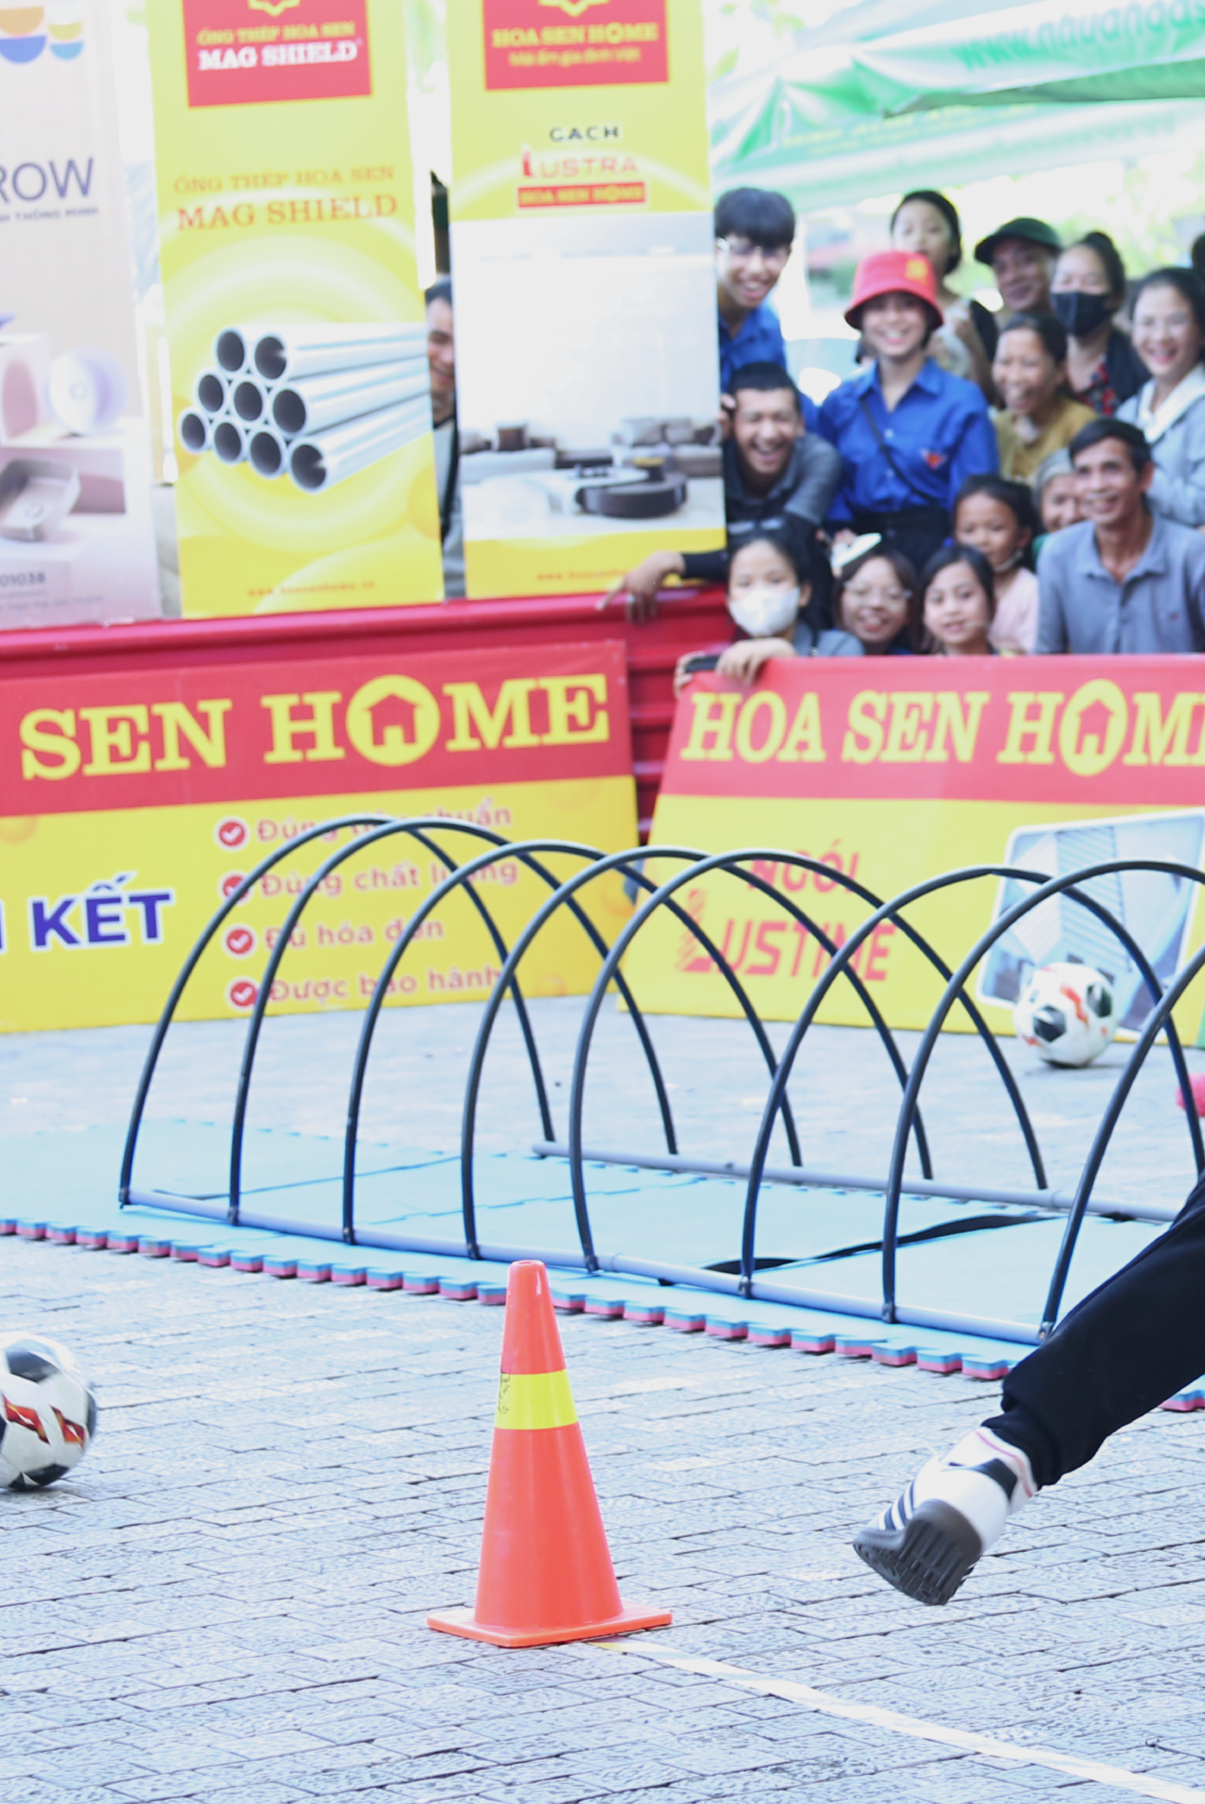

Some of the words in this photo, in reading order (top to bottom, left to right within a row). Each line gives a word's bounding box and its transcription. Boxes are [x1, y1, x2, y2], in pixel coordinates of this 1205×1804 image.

[282, 23, 320, 40] HOA
[320, 20, 356, 37] SEN
[492, 26, 541, 48] HOA
[540, 24, 586, 45] SEN
[587, 21, 659, 44] HOME
[198, 46, 258, 71] MAG
[261, 40, 358, 67] SHIELD
[295, 168, 344, 187] HOA
[350, 164, 395, 183] SEN
[177, 202, 256, 232] MAG
[266, 193, 399, 226] SHIELD
[19, 699, 232, 780] SEN
[261, 673, 610, 767] HOME
[680, 691, 827, 764] HOA
[842, 690, 991, 764] SEN
[31, 870, 172, 948] KẾT
[318, 920, 374, 945] hóa
